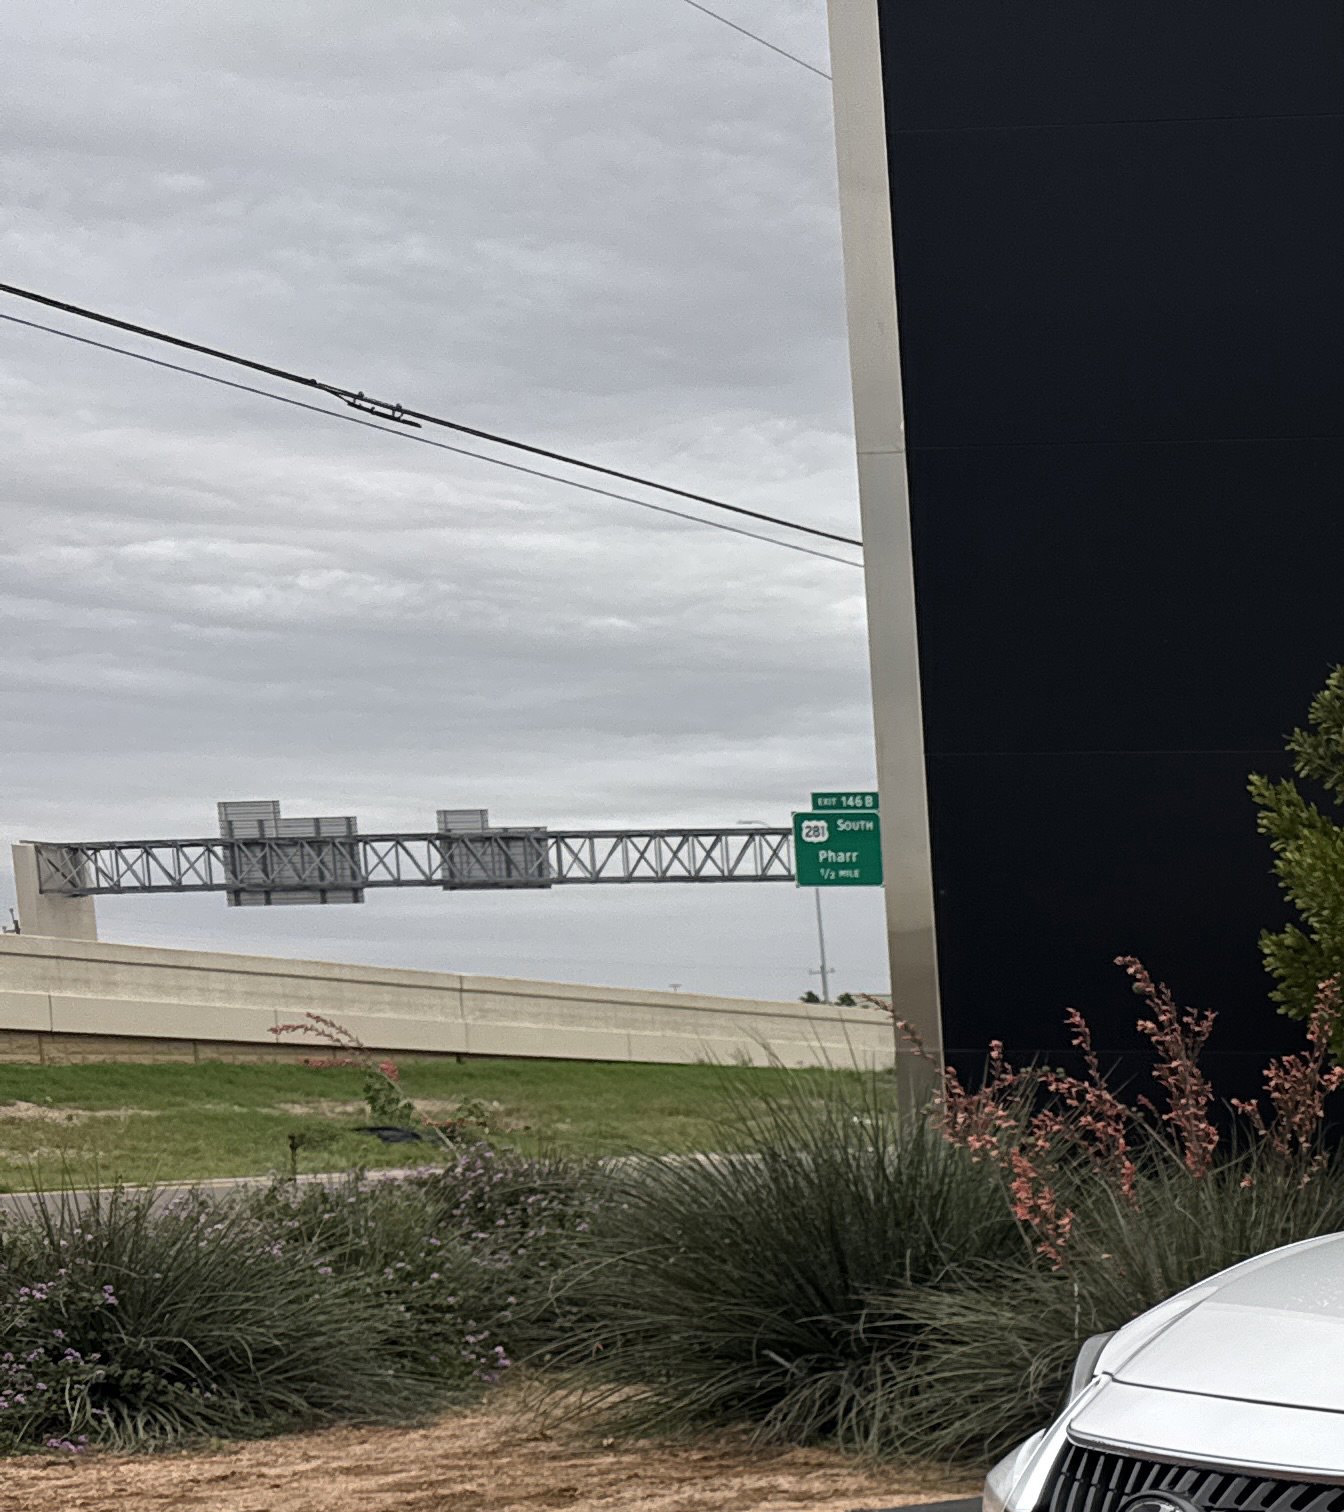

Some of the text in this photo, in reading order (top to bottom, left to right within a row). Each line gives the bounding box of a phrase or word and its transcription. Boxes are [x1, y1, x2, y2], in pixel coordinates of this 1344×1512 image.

[818, 798, 836, 806] EXIT
[805, 826, 824, 838] 281
[818, 850, 858, 863] Pharr
[838, 870, 859, 878] MILE
